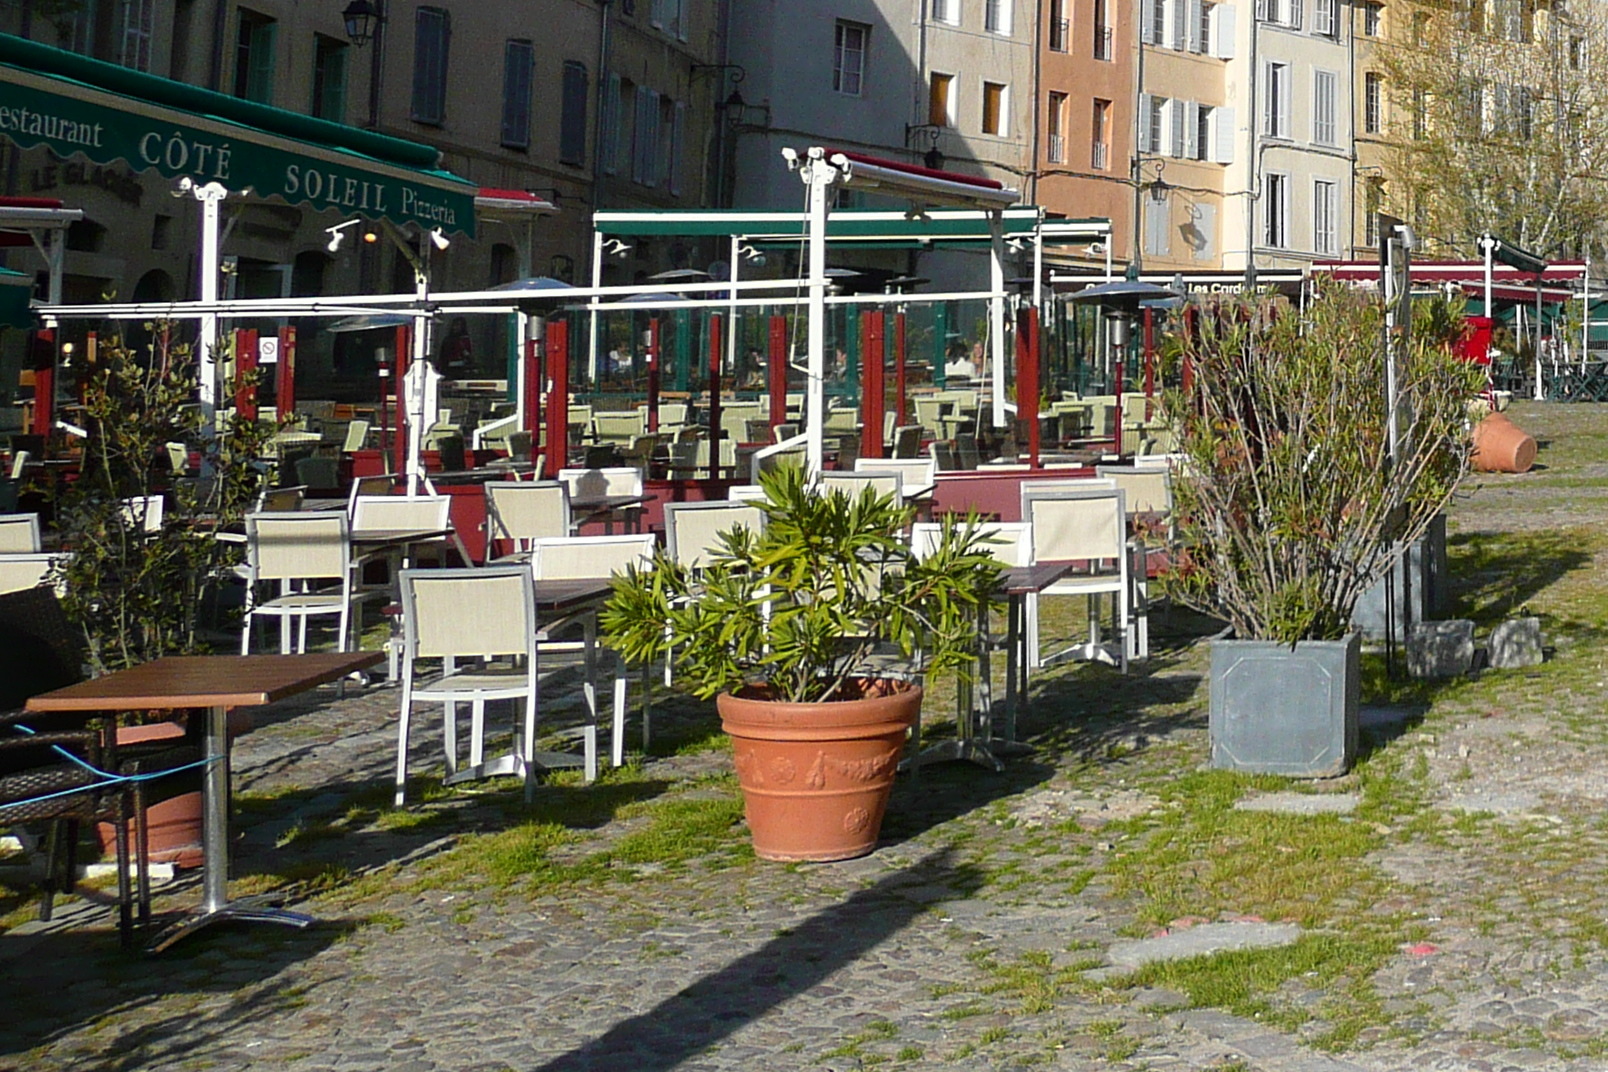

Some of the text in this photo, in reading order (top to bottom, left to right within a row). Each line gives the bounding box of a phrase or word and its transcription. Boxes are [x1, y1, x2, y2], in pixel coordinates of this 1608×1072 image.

[0, 105, 456, 225] estaurant CÔTÉ SOLEIL Pizzeria
[1188, 282, 1208, 295] Les
